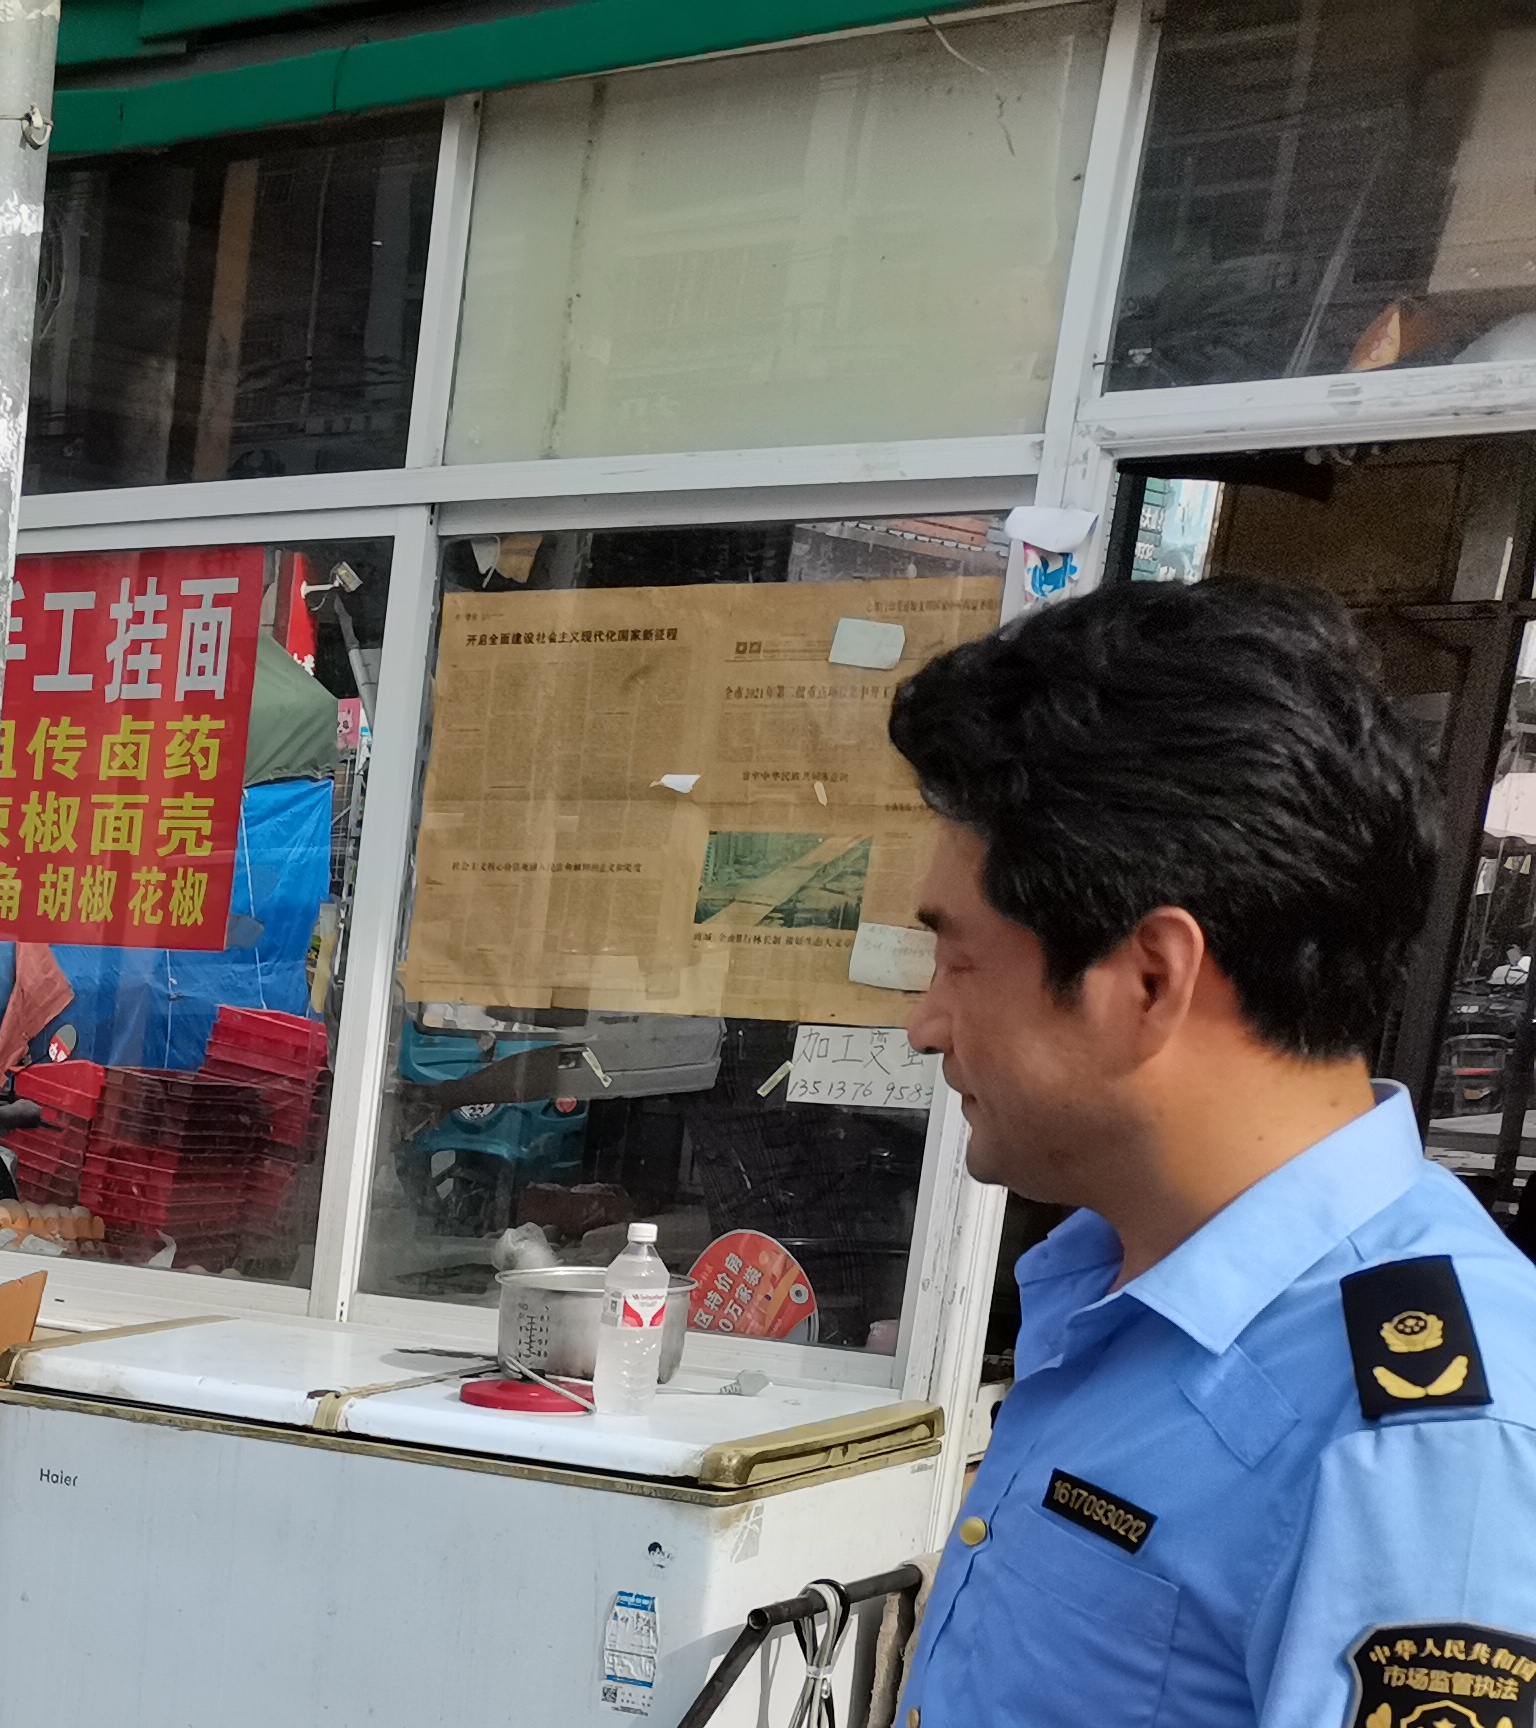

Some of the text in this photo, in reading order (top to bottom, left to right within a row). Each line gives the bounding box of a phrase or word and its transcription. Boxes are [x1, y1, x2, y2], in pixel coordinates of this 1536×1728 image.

[37, 863, 118, 923] 胡椒
[128, 865, 210, 927] 花椒
[40, 1468, 78, 1487] Haier
[1369, 1637, 1536, 1682] 中华人民共和国
[1383, 1664, 1519, 1701] 市场监管执法
